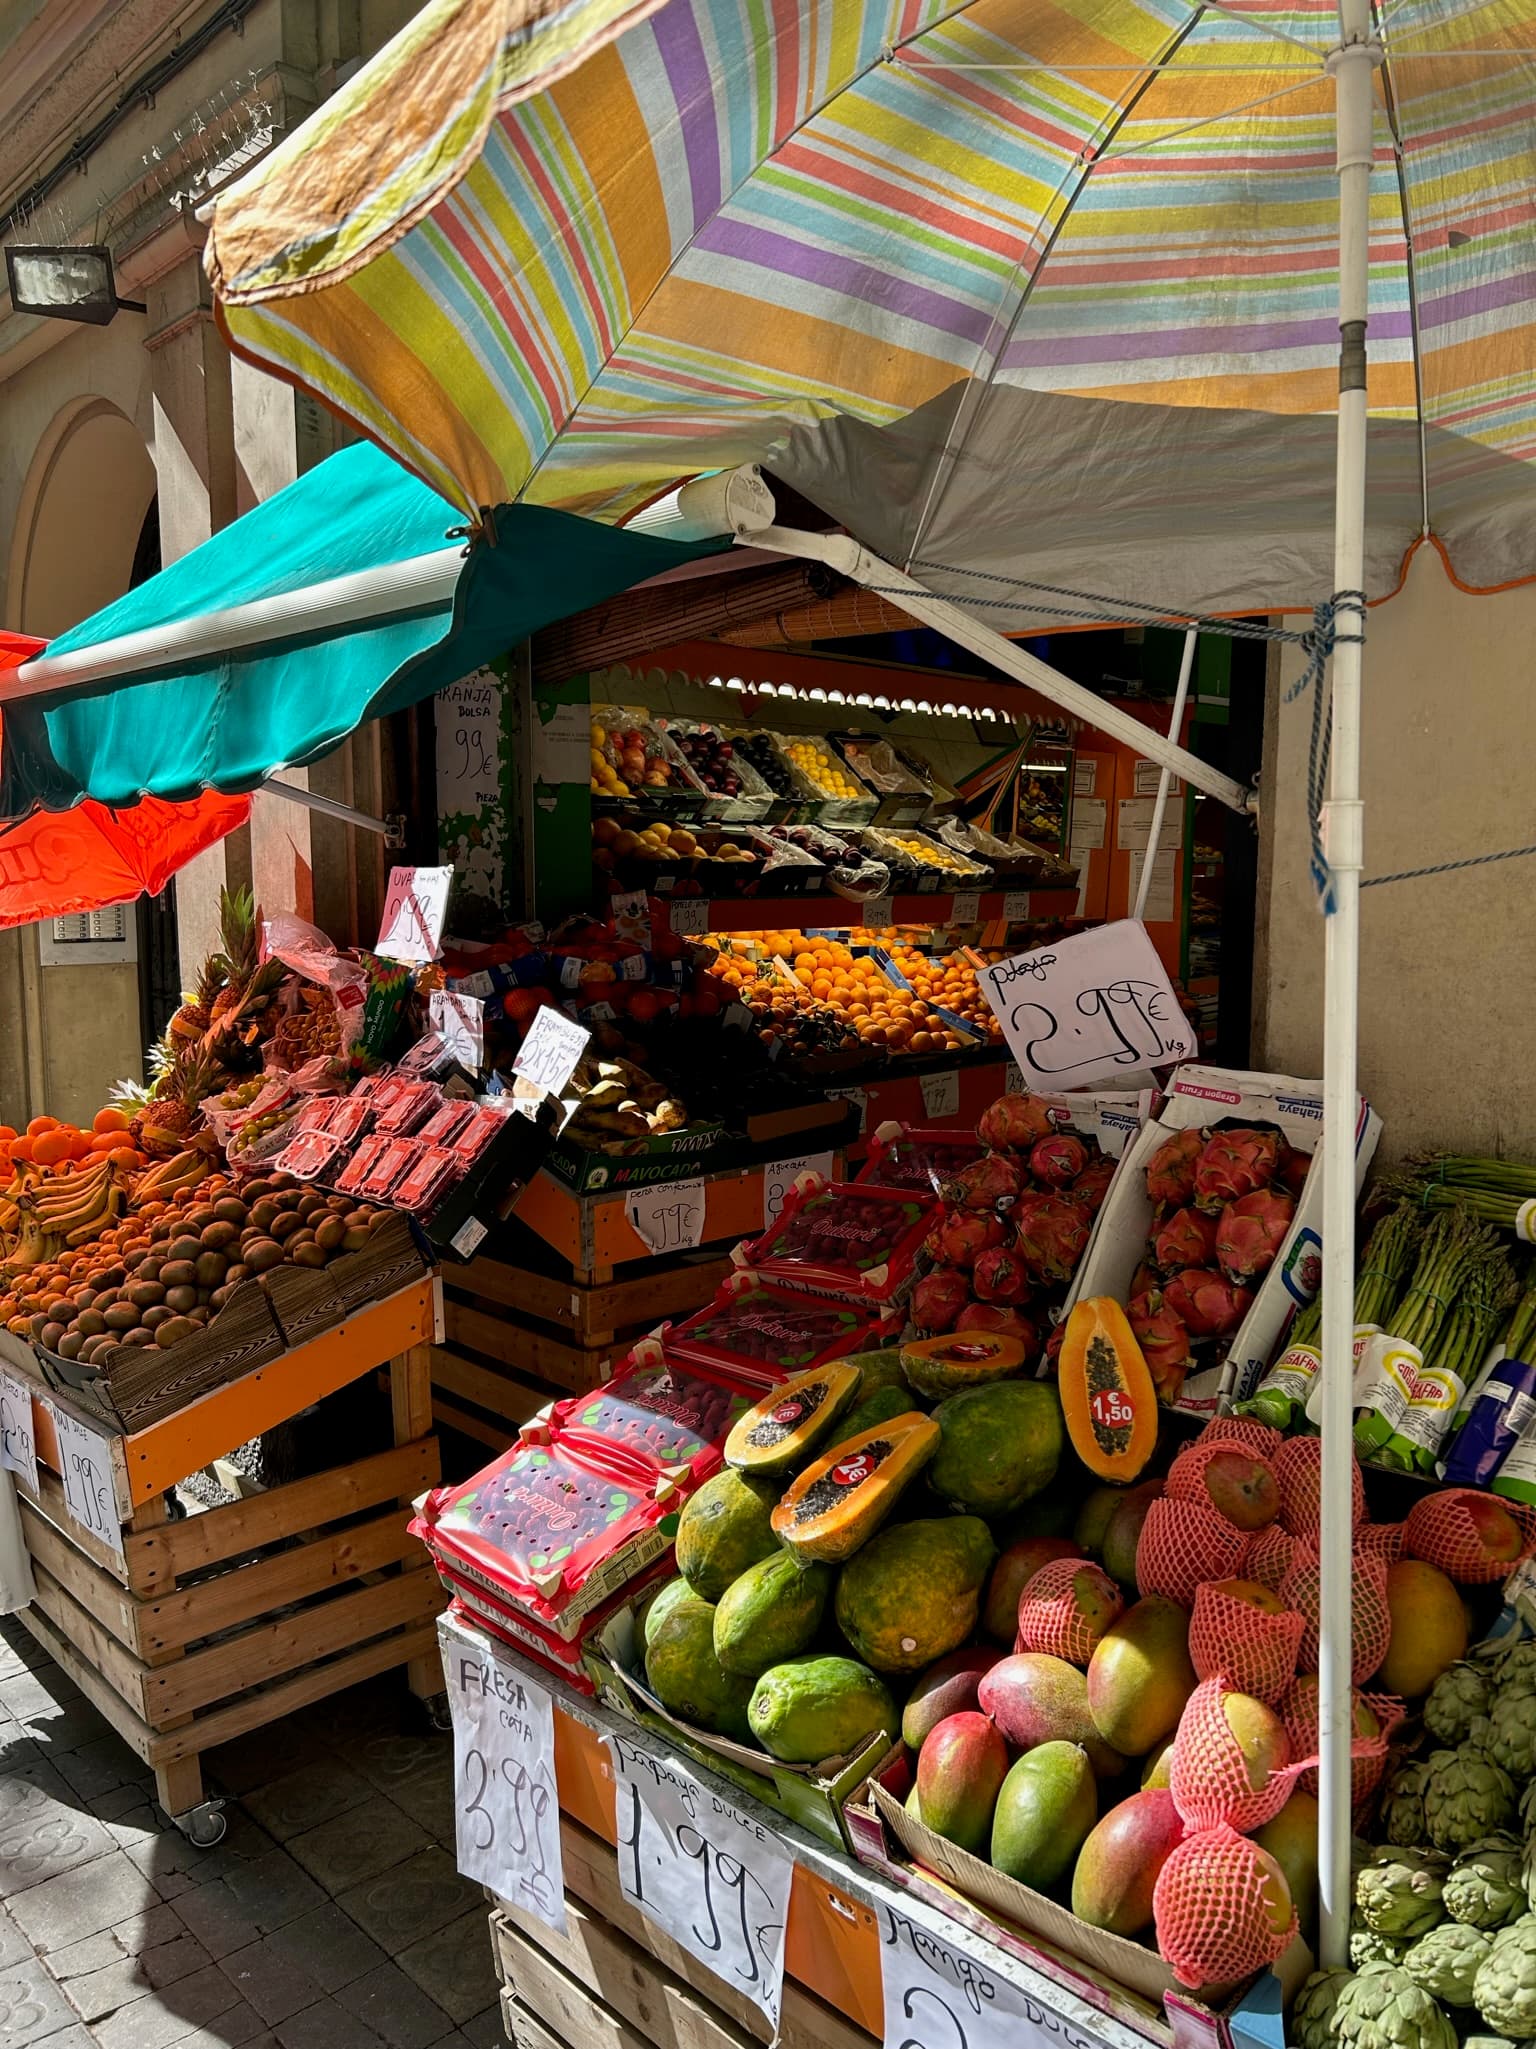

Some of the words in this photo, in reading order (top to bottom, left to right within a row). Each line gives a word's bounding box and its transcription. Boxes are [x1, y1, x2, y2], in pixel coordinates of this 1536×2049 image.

[458, 705, 491, 718] BOLSA
[1205, 1088, 1237, 1104] Dragon
[1278, 1104, 1324, 1122] itahaya
[613, 1161, 701, 1183] MAVOCADO
[1093, 1396, 1133, 1427] 1,50
[837, 1455, 869, 1484] 2€
[460, 1658, 528, 1711] FRESA
[711, 1797, 767, 1843] DULCE
[886, 1906, 996, 2015] Mango
